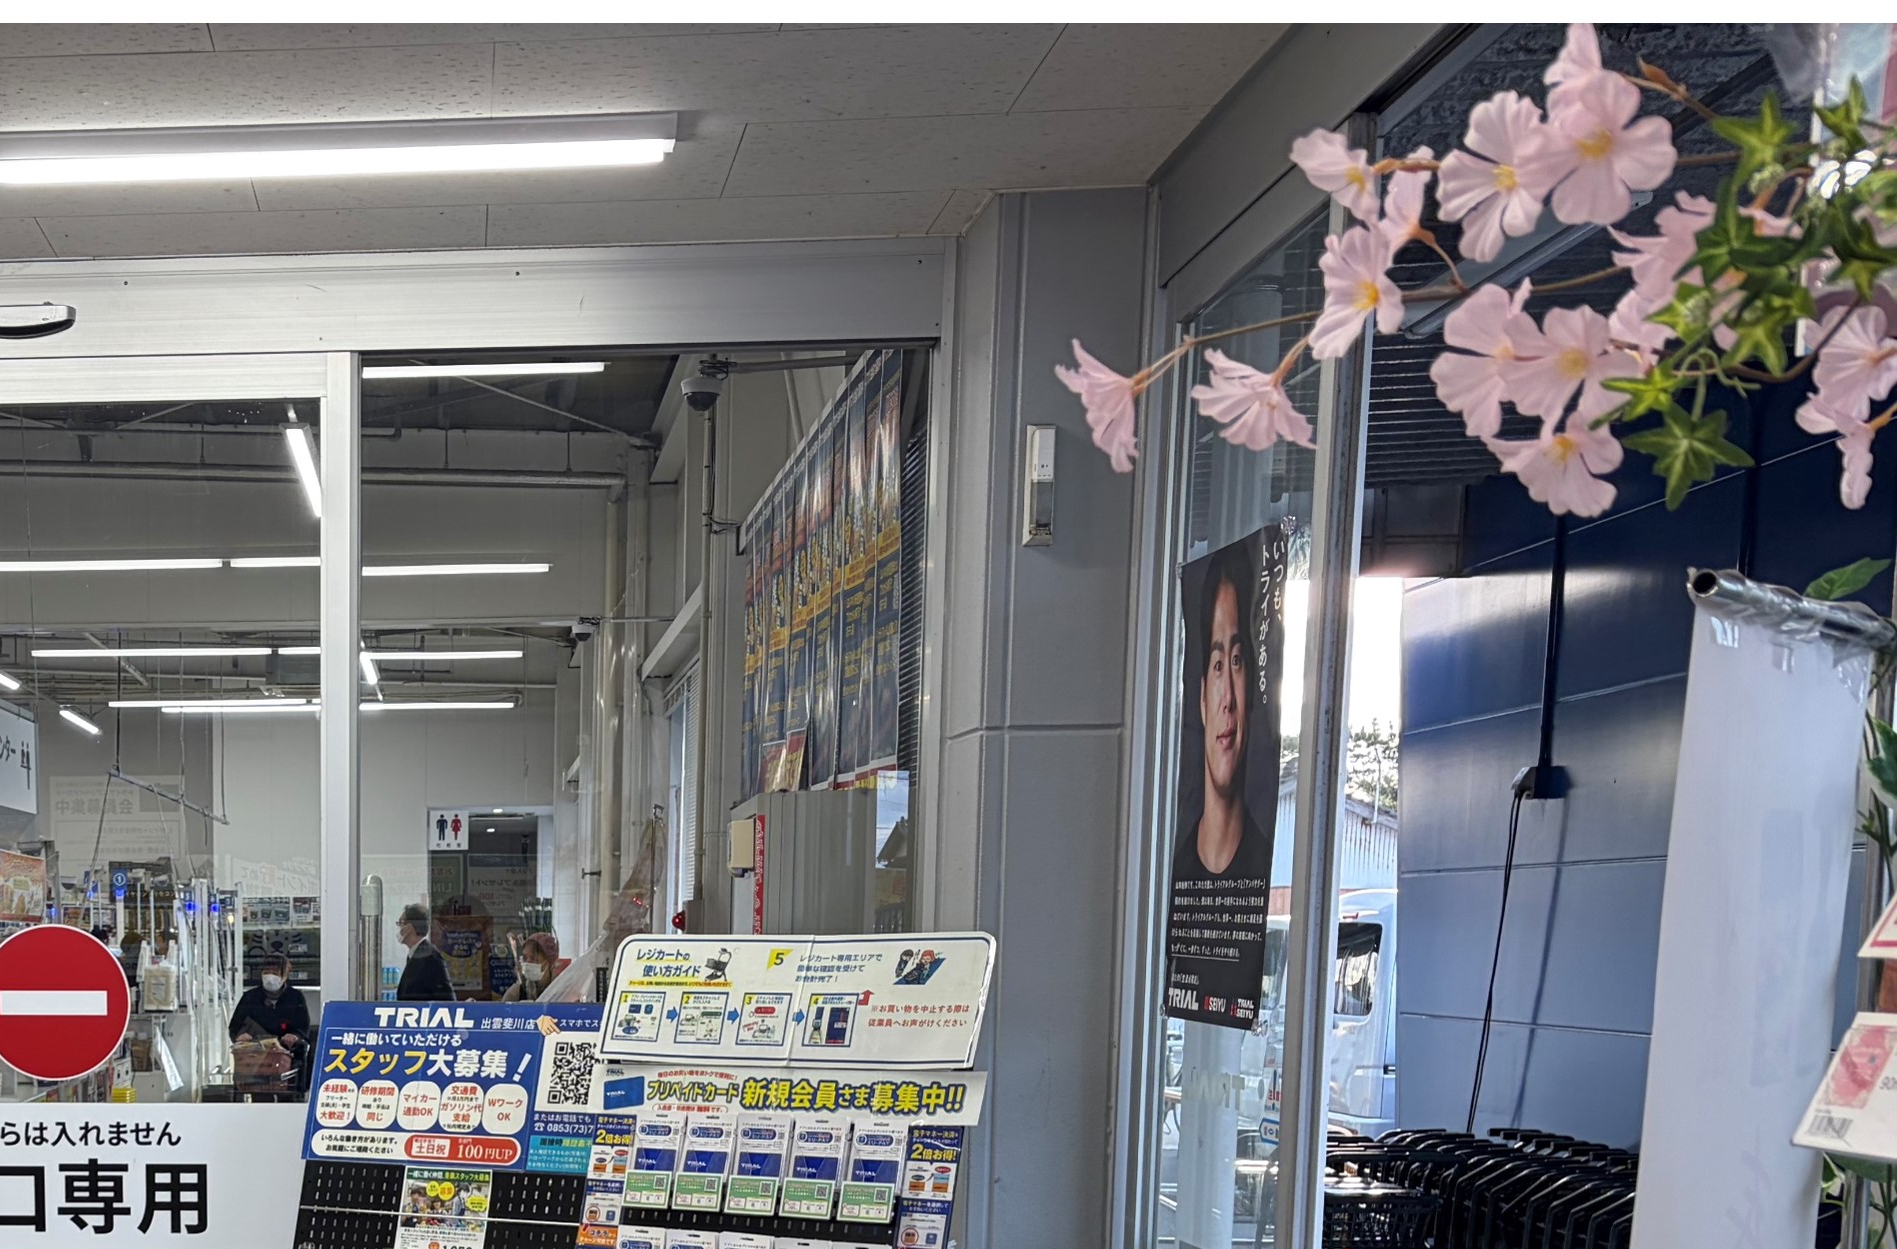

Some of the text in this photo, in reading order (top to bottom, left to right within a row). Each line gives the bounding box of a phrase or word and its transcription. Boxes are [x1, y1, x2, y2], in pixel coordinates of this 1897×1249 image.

[637, 948, 690, 961] レジカートの
[773, 952, 784, 965] 5
[800, 954, 883, 963] レジカート専用エリアで
[643, 965, 701, 978] 使い方ガイド
[1168, 987, 1199, 1011] TRIAL
[1209, 997, 1226, 1013] SEIYU
[374, 1008, 536, 1030] TRIAL 出雲斐川店
[559, 1019, 602, 1028] スマホでス
[868, 1018, 967, 1028] 従業員へお声がけください
[331, 1032, 462, 1047] 一緒に働いていただける
[324, 1047, 532, 1083] スタッフ大募集!
[361, 1086, 396, 1097] 研修期間
[450, 1085, 478, 1096] 交通費
[647, 1077, 966, 1115] プリペイドカード 新規会員さま募集中!!
[403, 1093, 438, 1103] マイカー
[488, 1097, 524, 1108] Wワーク
[403, 1106, 434, 1116] 通勤OK
[441, 1102, 483, 1113] ガソリン代
[366, 1112, 384, 1122] 同じ
[453, 1113, 471, 1122] 支給
[497, 1112, 511, 1121] OK
[533, 1114, 592, 1123] またはお電話でも
[416, 1143, 446, 1155] 土日祝
[456, 1144, 513, 1160] 100円UP
